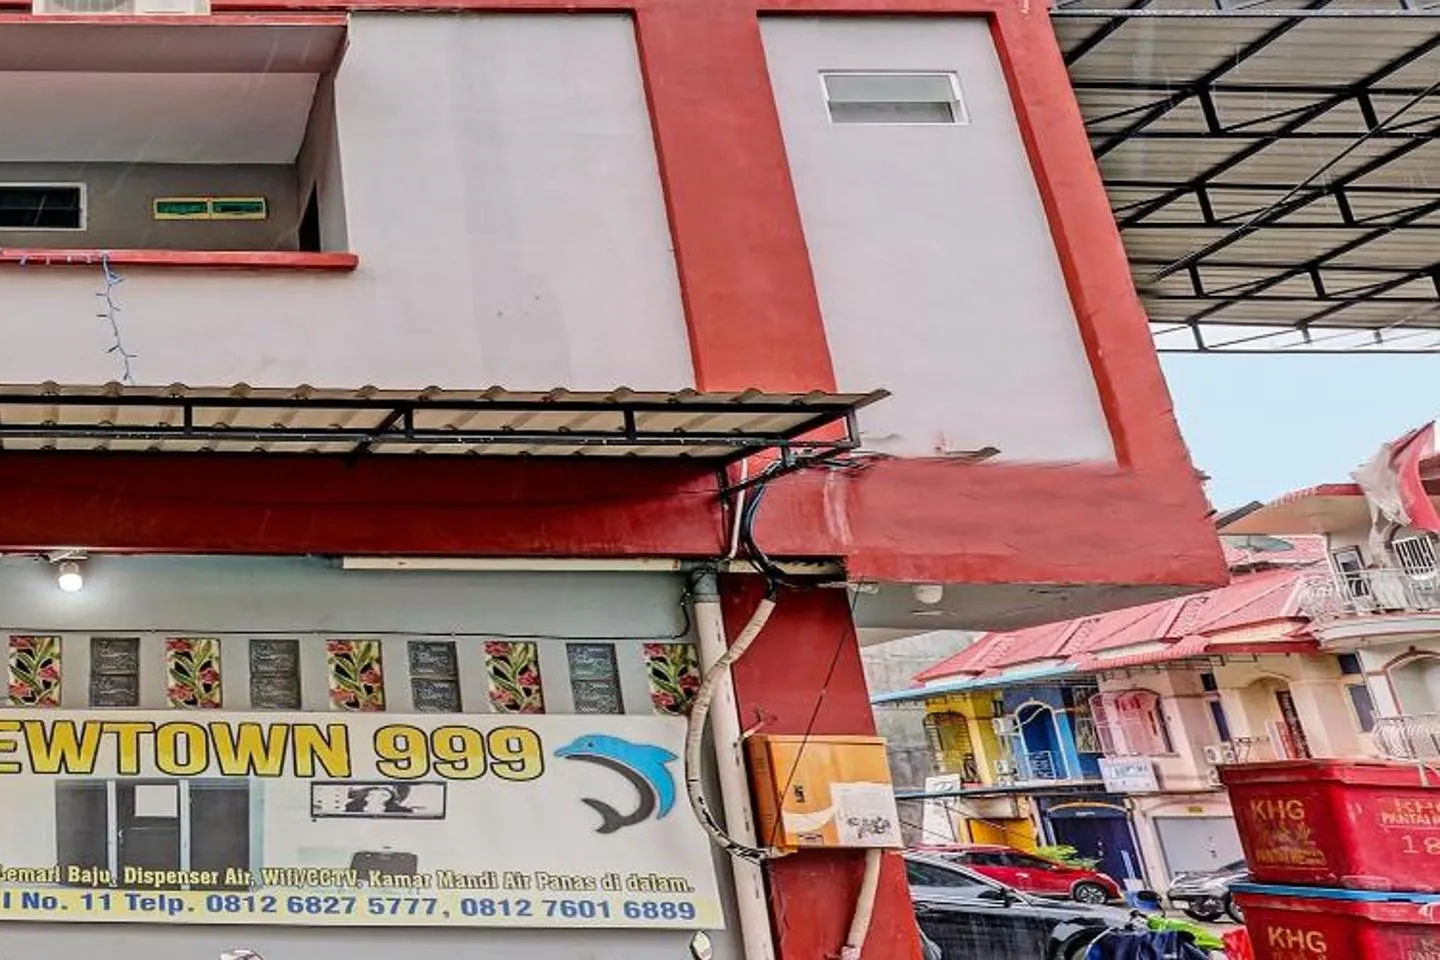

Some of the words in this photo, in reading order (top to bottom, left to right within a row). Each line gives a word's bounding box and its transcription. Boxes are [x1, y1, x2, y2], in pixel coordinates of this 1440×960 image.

[373, 724, 545, 781] 999
[1250, 800, 1305, 820] KHG
[124, 867, 218, 888] Dispenser
[369, 871, 432, 889] Kamar
[437, 870, 497, 890] Mandi
[502, 871, 531, 890] Air
[535, 873, 596, 891] Panas
[601, 872, 622, 891] di
[628, 874, 695, 893] dalam.
[21, 891, 69, 910] No.
[80, 893, 111, 911] 11
[124, 893, 196, 915] Telp.
[206, 895, 277, 914] 0812
[287, 896, 356, 915] 6827
[368, 897, 450, 918] 5777,
[460, 898, 533, 917] 0812
[542, 900, 611, 919] 7601
[623, 901, 696, 920] 6889
[1266, 926, 1327, 953] KHG
